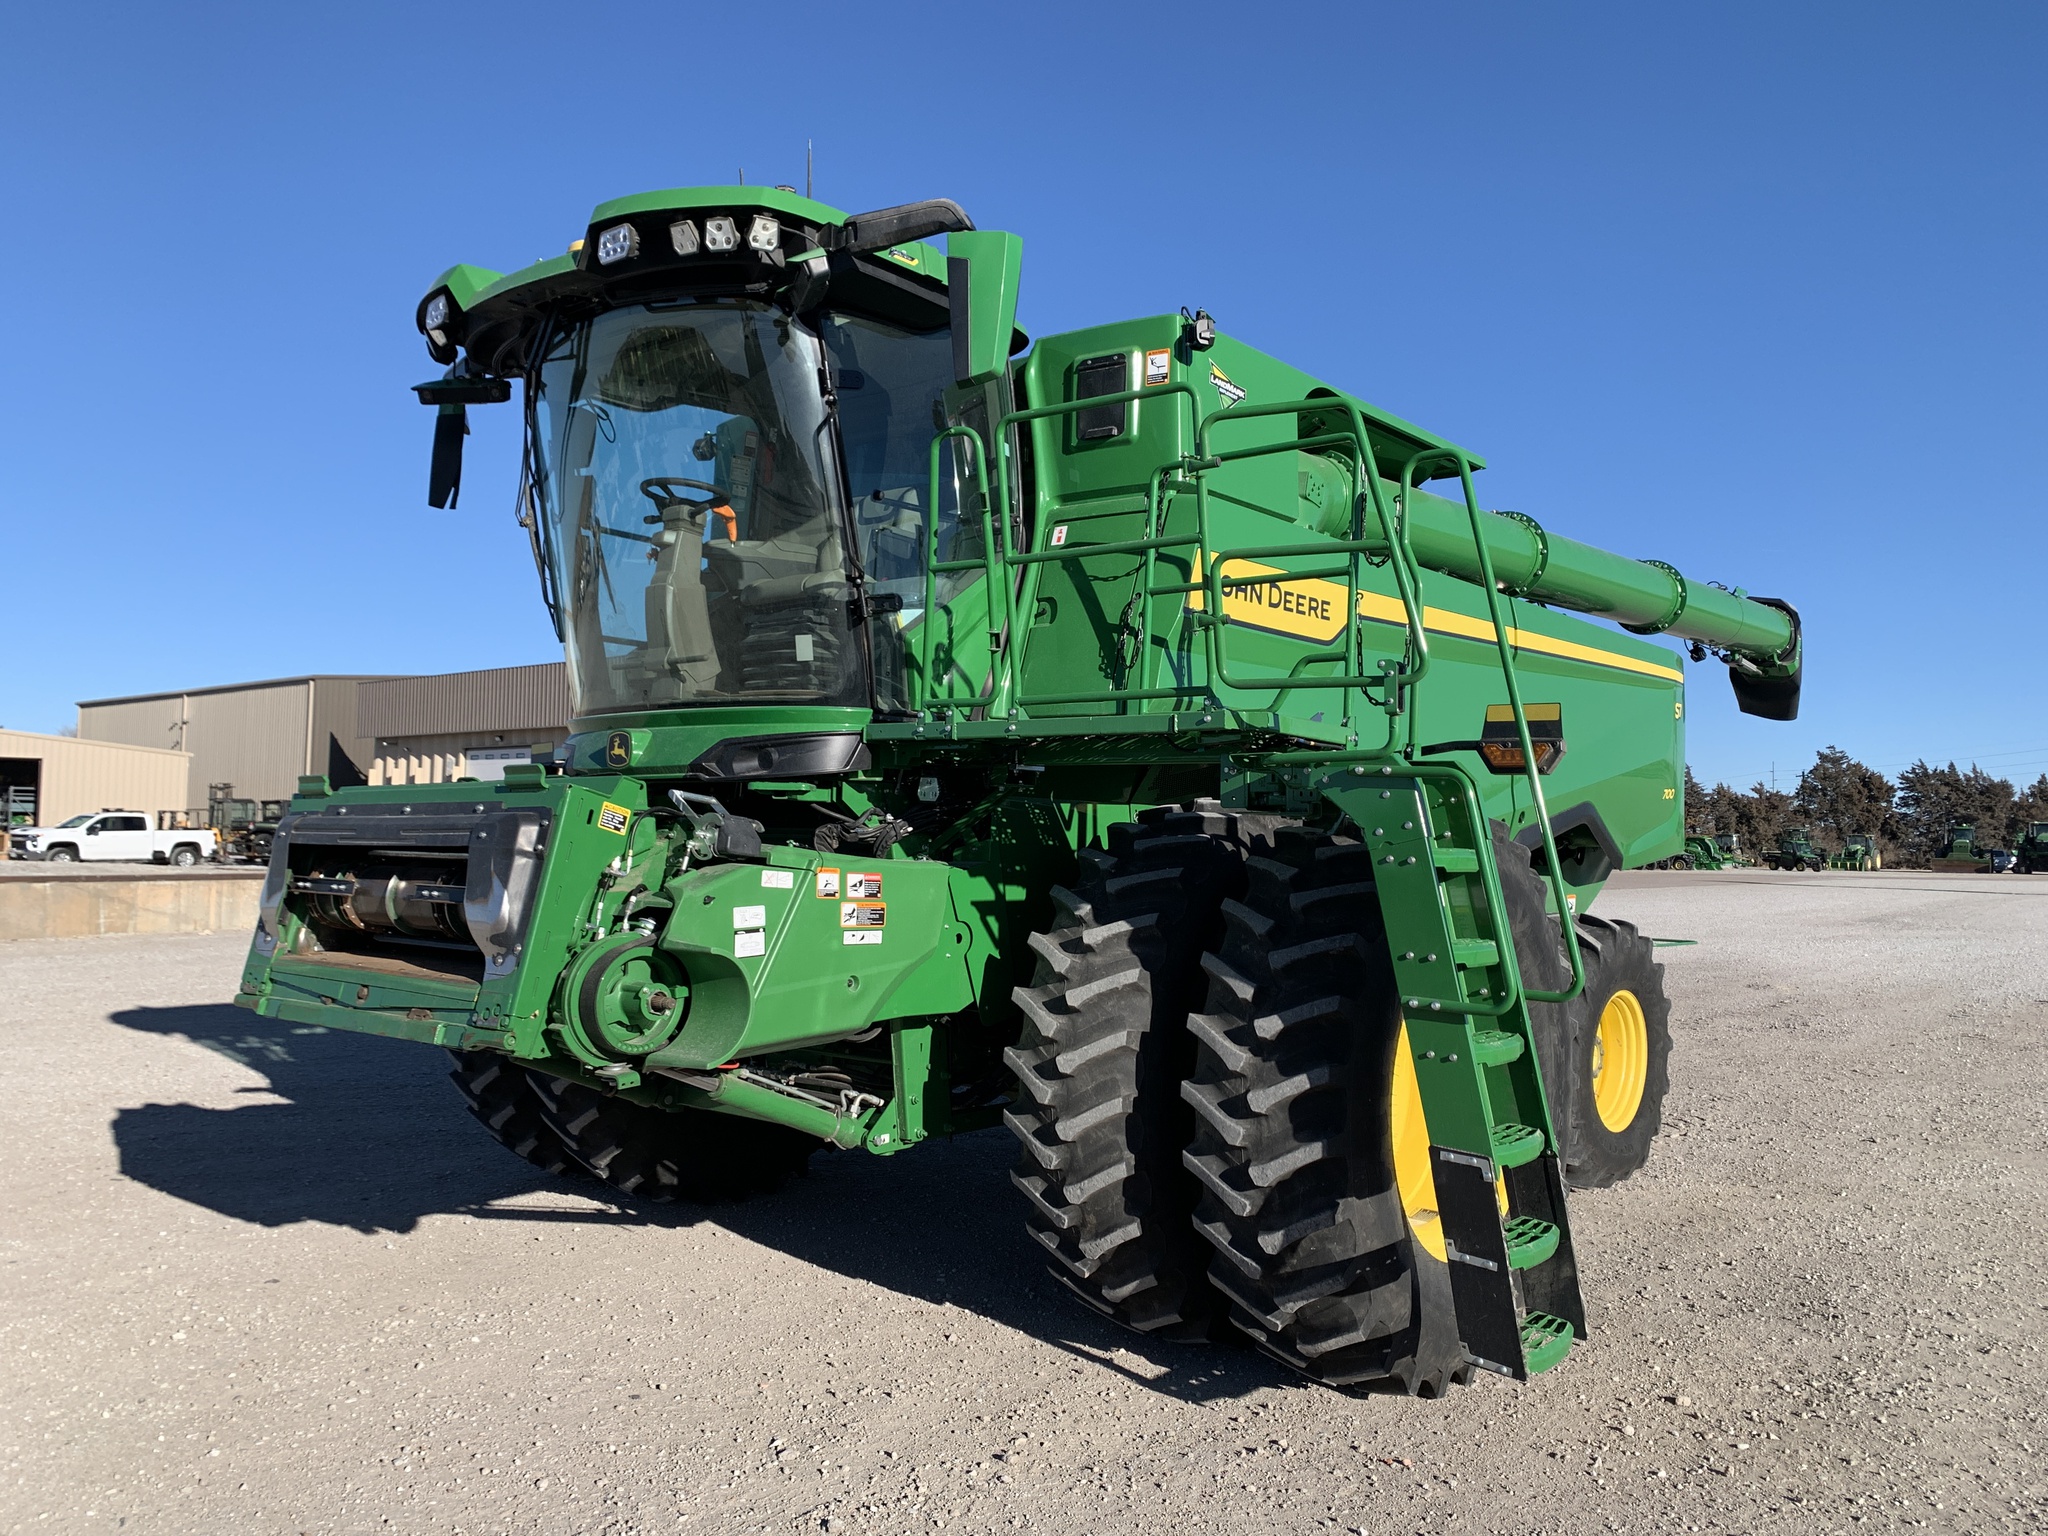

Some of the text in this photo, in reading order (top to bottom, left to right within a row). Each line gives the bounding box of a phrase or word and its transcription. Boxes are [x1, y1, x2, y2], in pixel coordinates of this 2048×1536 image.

[1222, 575, 1330, 621] OHN DEERE
[1662, 788, 1675, 800] 700
